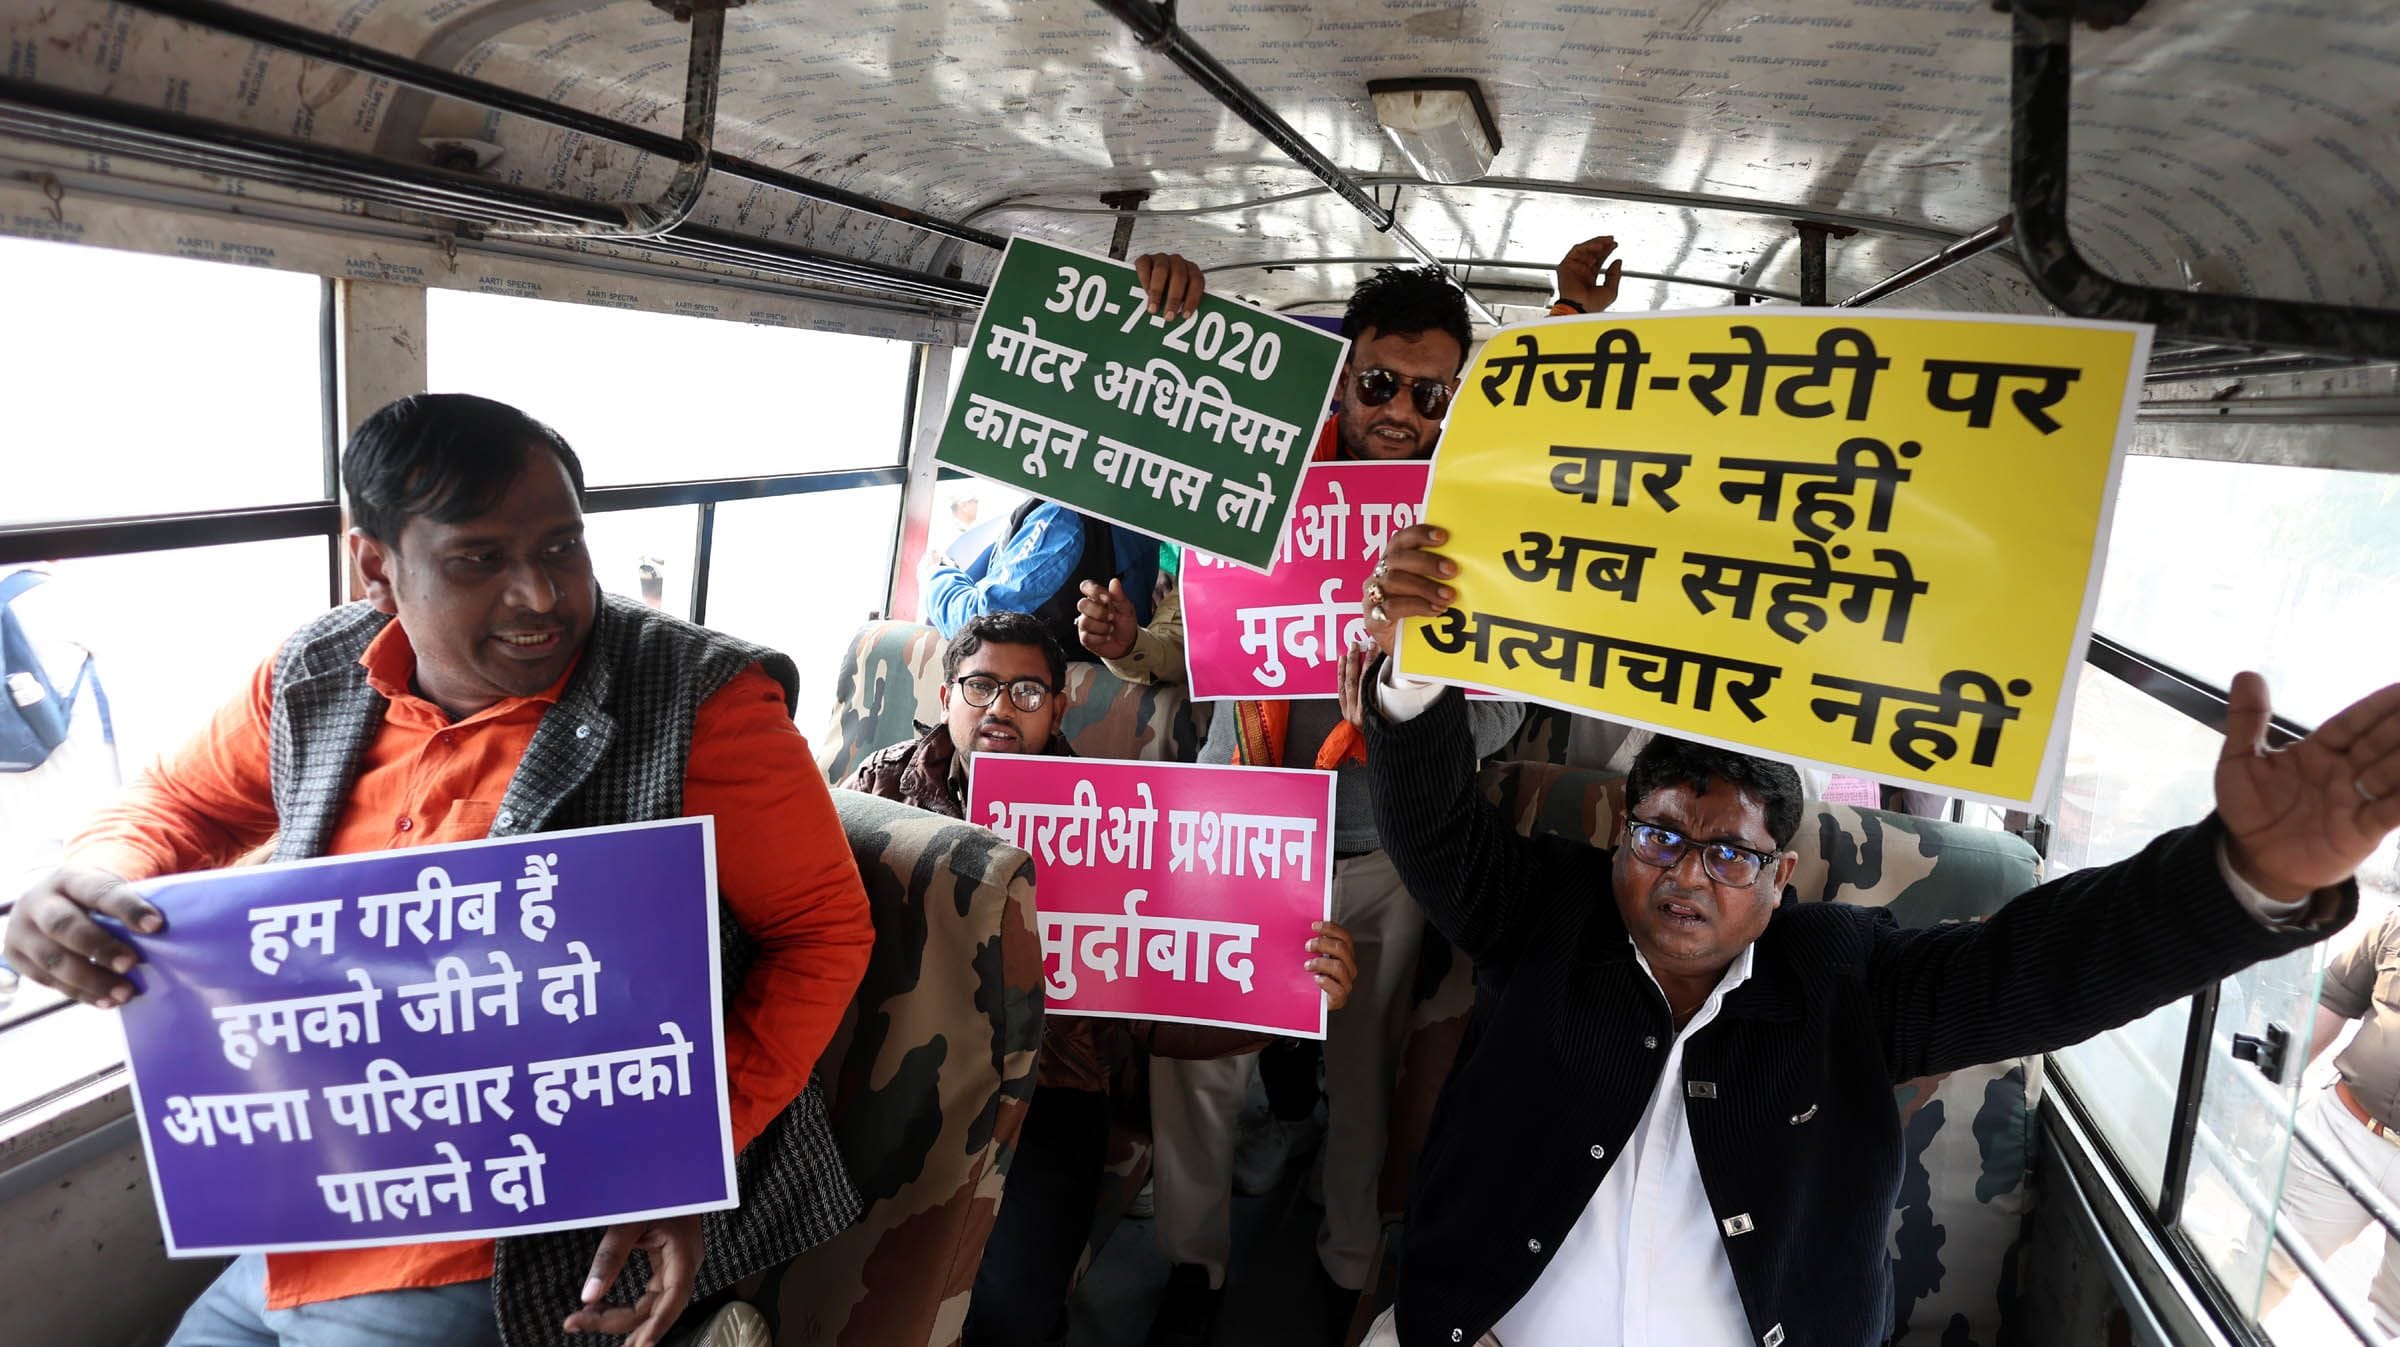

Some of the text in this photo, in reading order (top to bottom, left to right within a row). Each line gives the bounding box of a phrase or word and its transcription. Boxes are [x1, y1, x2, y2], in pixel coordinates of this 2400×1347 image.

[479, 275, 542, 291] AARTI SPECTRA
[1044, 266, 1281, 381] 30-7-2020
[986, 316, 1302, 465] मोटर अधिनियम
[1480, 325, 2082, 435] रोजी-रोटी पर
[964, 393, 1088, 478] कानून
[1093, 434, 1213, 512] वापस
[1216, 472, 1276, 534] लो
[1547, 436, 1923, 542] वार नहीं
[1501, 530, 1930, 645] अब सहेंगे
[1420, 606, 2034, 773] अत्याचार नहीं
[983, 779, 1317, 882] आरटीओ प्रशासन
[248, 853, 559, 975] हम गरीब हैं
[1037, 889, 1259, 1001] मुर्दाबाद
[213, 940, 601, 1071] हमको जीने दो
[162, 1021, 696, 1147] अपना परिवार हमको
[318, 1132, 547, 1223] पालने दो
